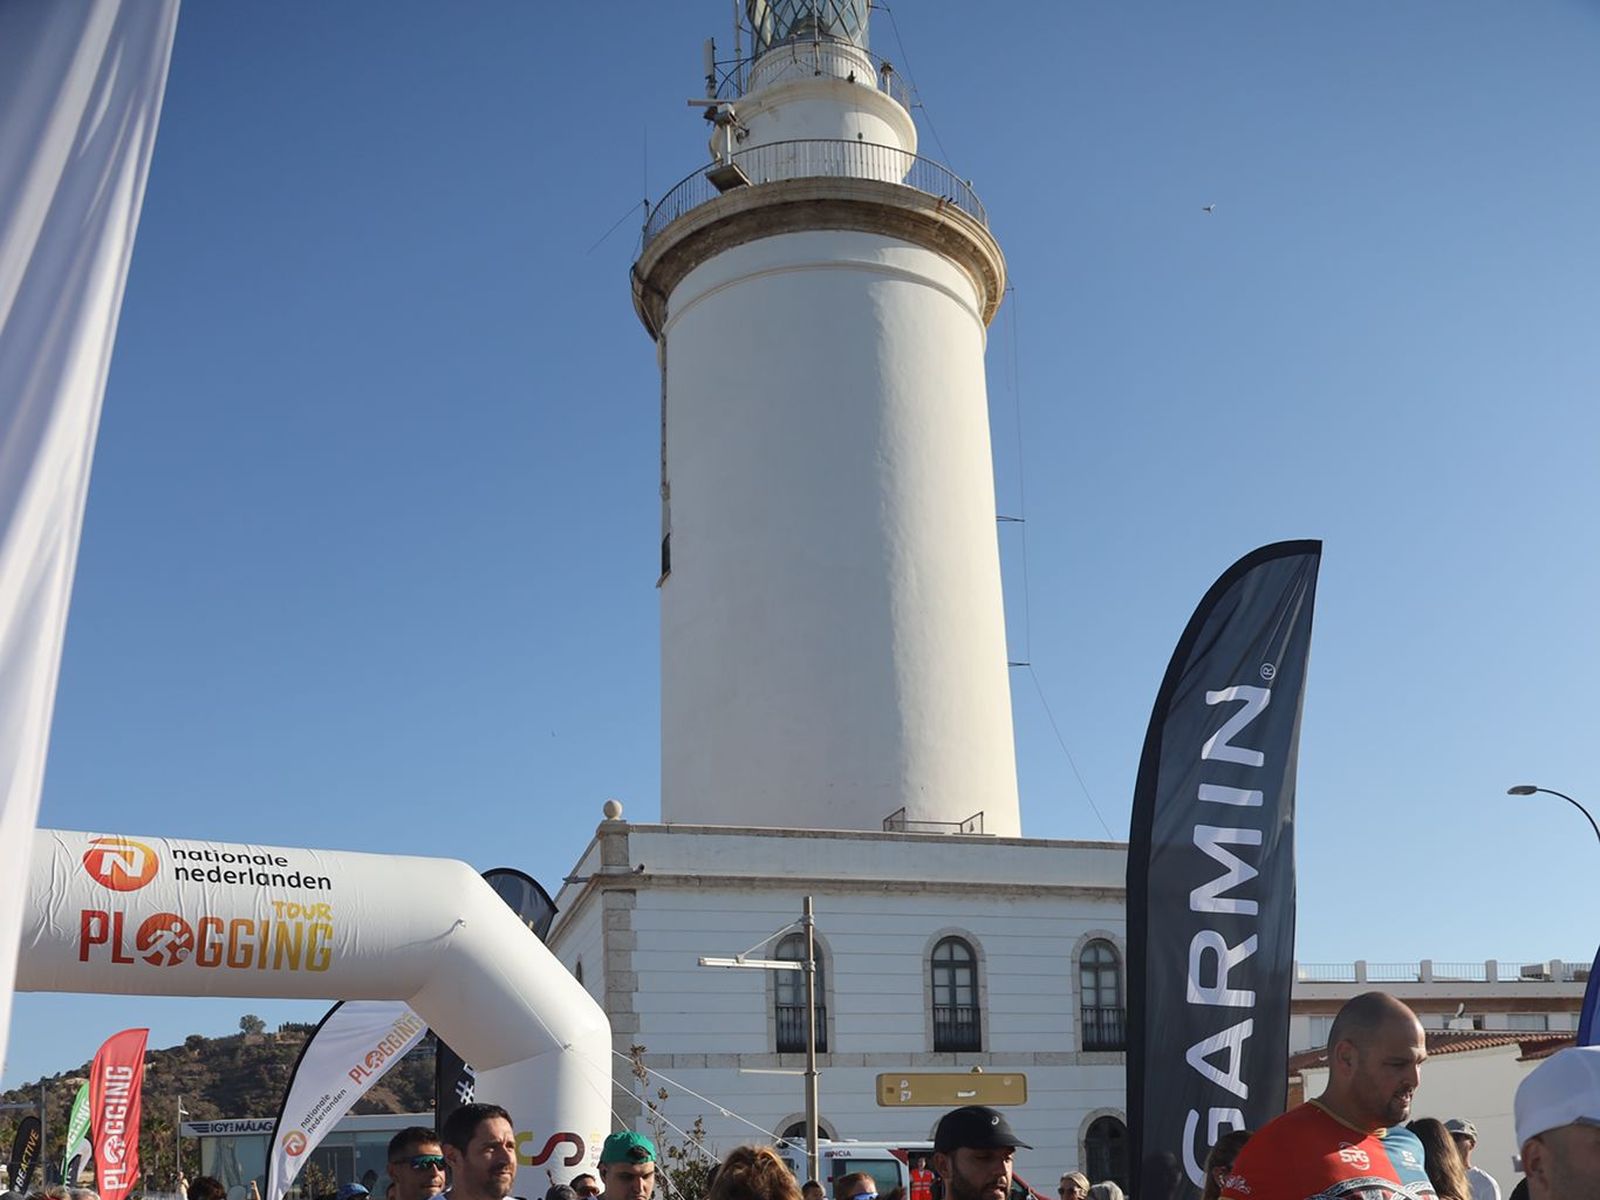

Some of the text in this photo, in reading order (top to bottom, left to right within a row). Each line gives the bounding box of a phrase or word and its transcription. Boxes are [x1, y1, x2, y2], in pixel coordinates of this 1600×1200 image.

[172, 849, 288, 867] nationale
[175, 866, 332, 890] nederlanden
[271, 900, 333, 921] TOUR
[301, 1093, 331, 1128] nationale
[307, 1088, 347, 1134] nederlanden
[235, 1120, 272, 1132] MÁLAG
